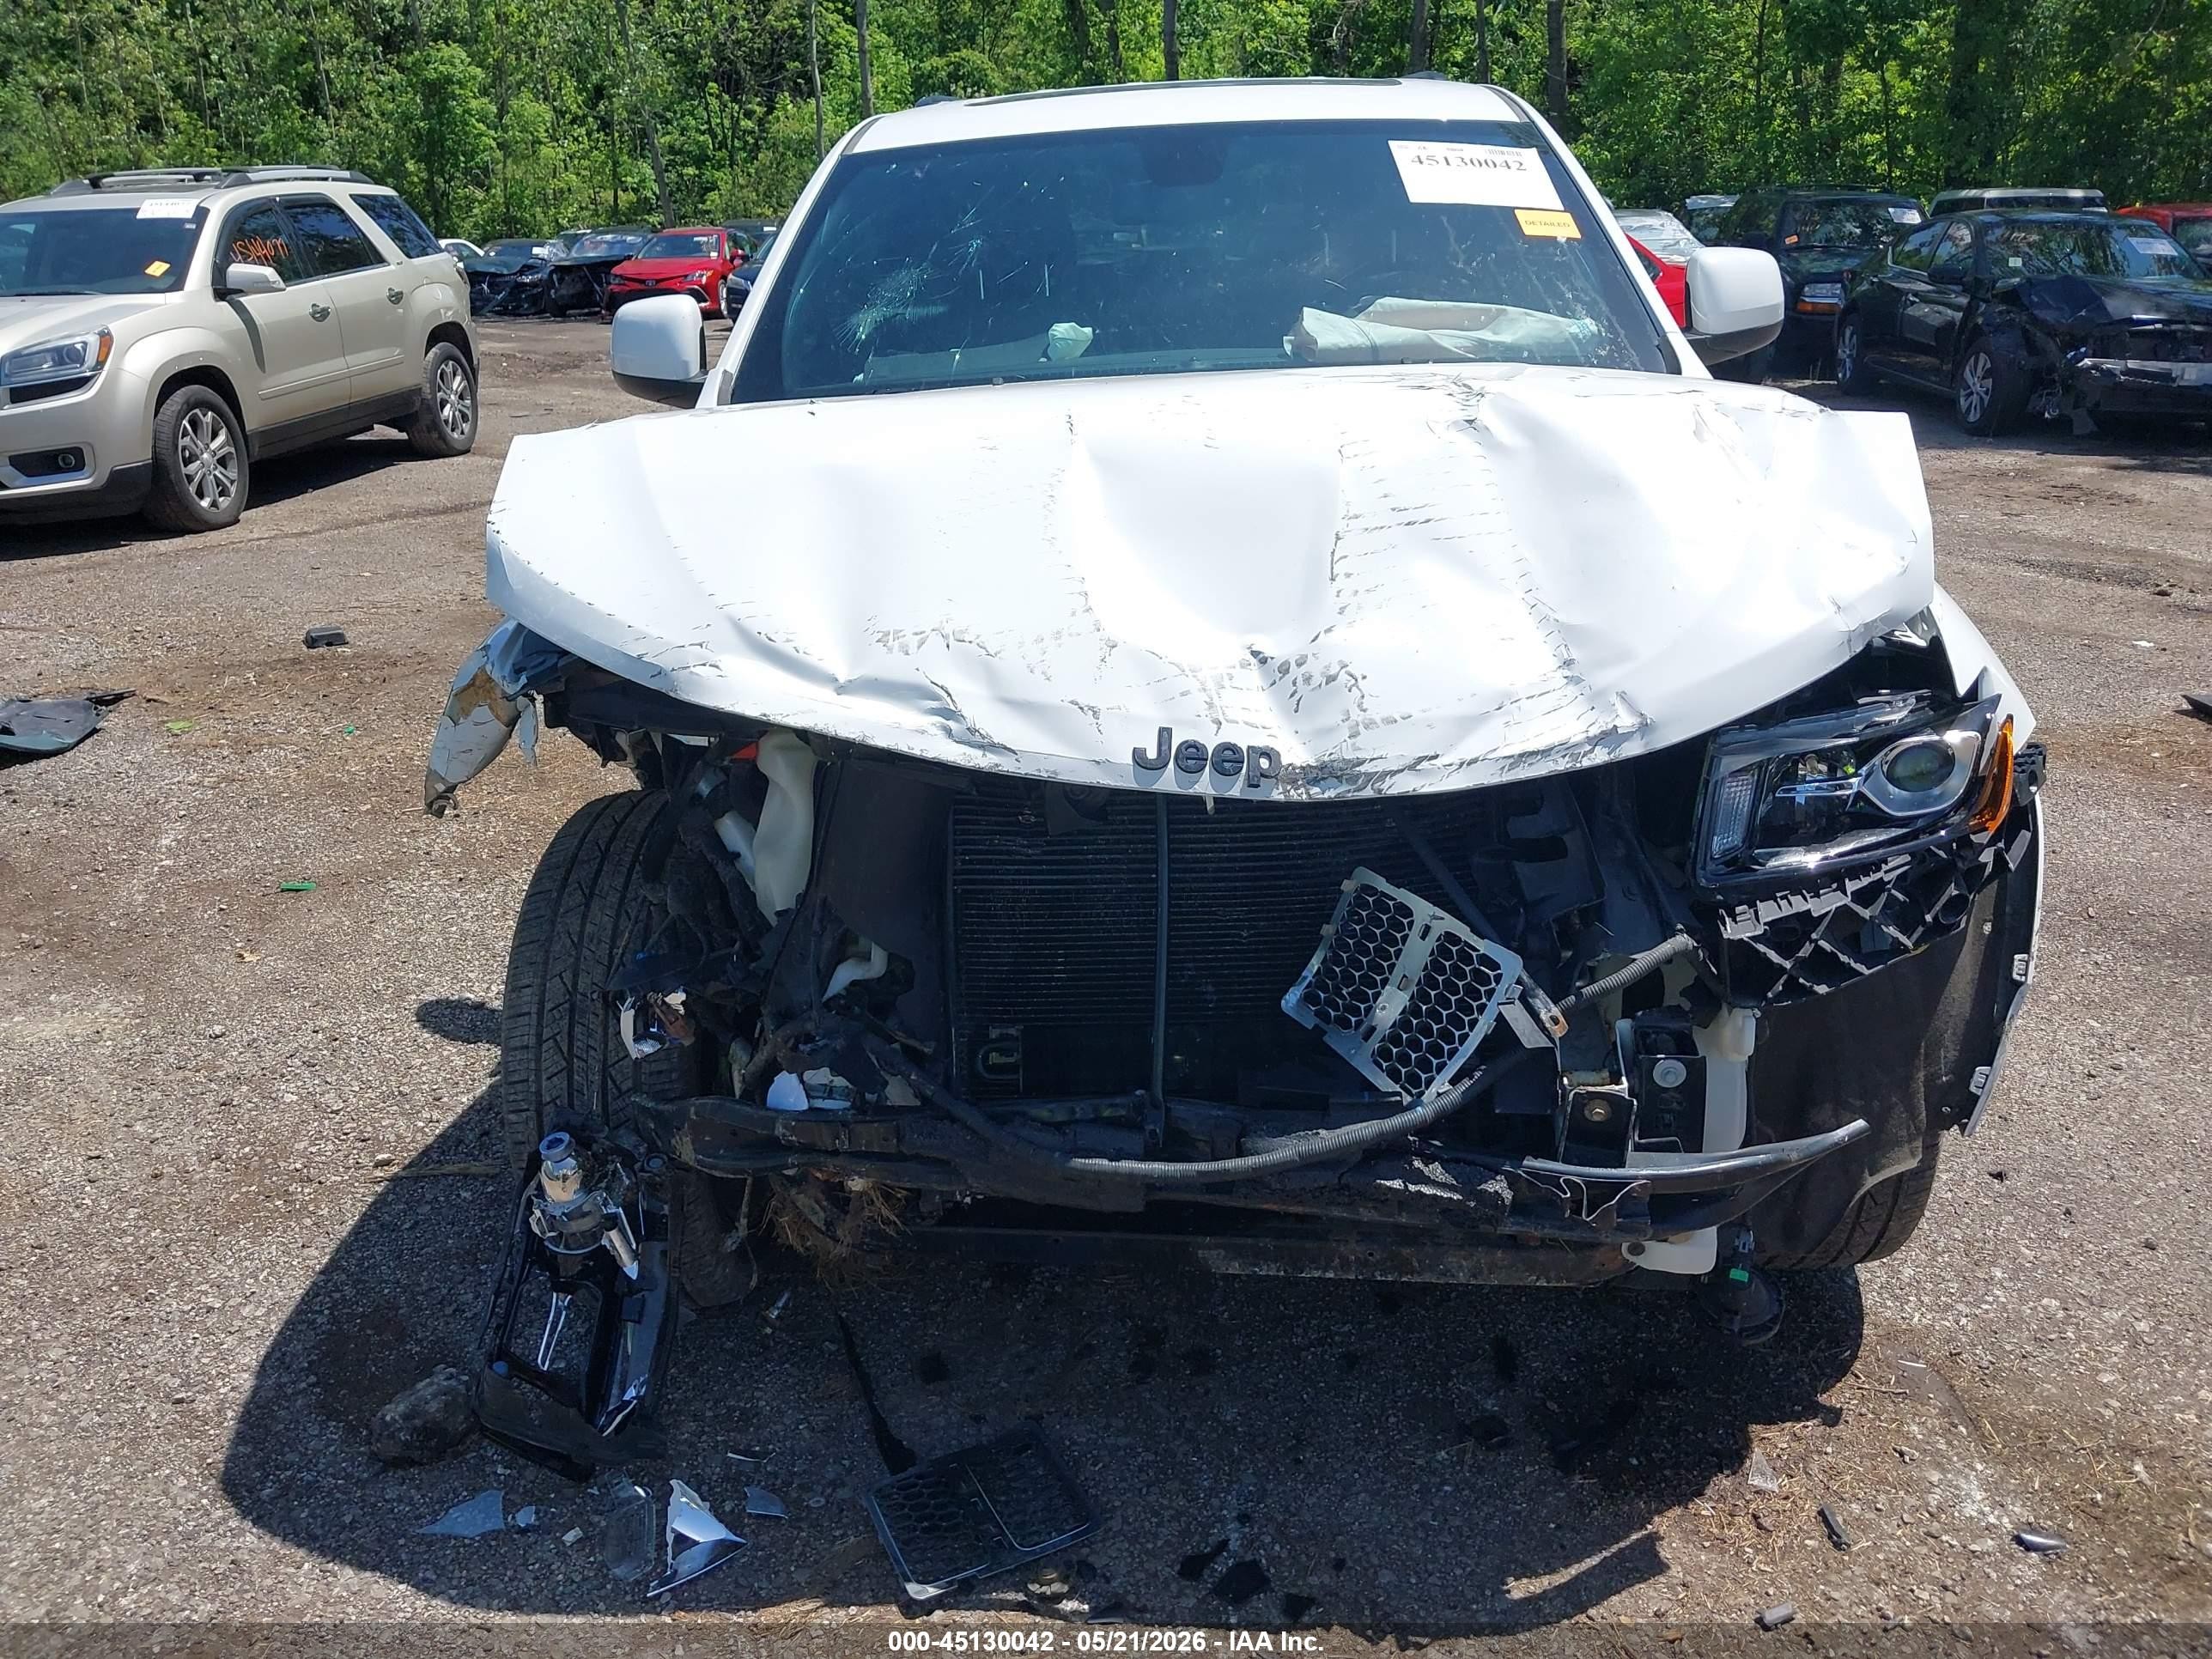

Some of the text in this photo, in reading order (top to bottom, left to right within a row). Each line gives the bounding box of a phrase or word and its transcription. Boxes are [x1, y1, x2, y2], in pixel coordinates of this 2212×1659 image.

[1411, 154, 1527, 171] 45130042
[1524, 219, 1571, 228] DETAILED
[1132, 726, 1282, 788] Jeep
